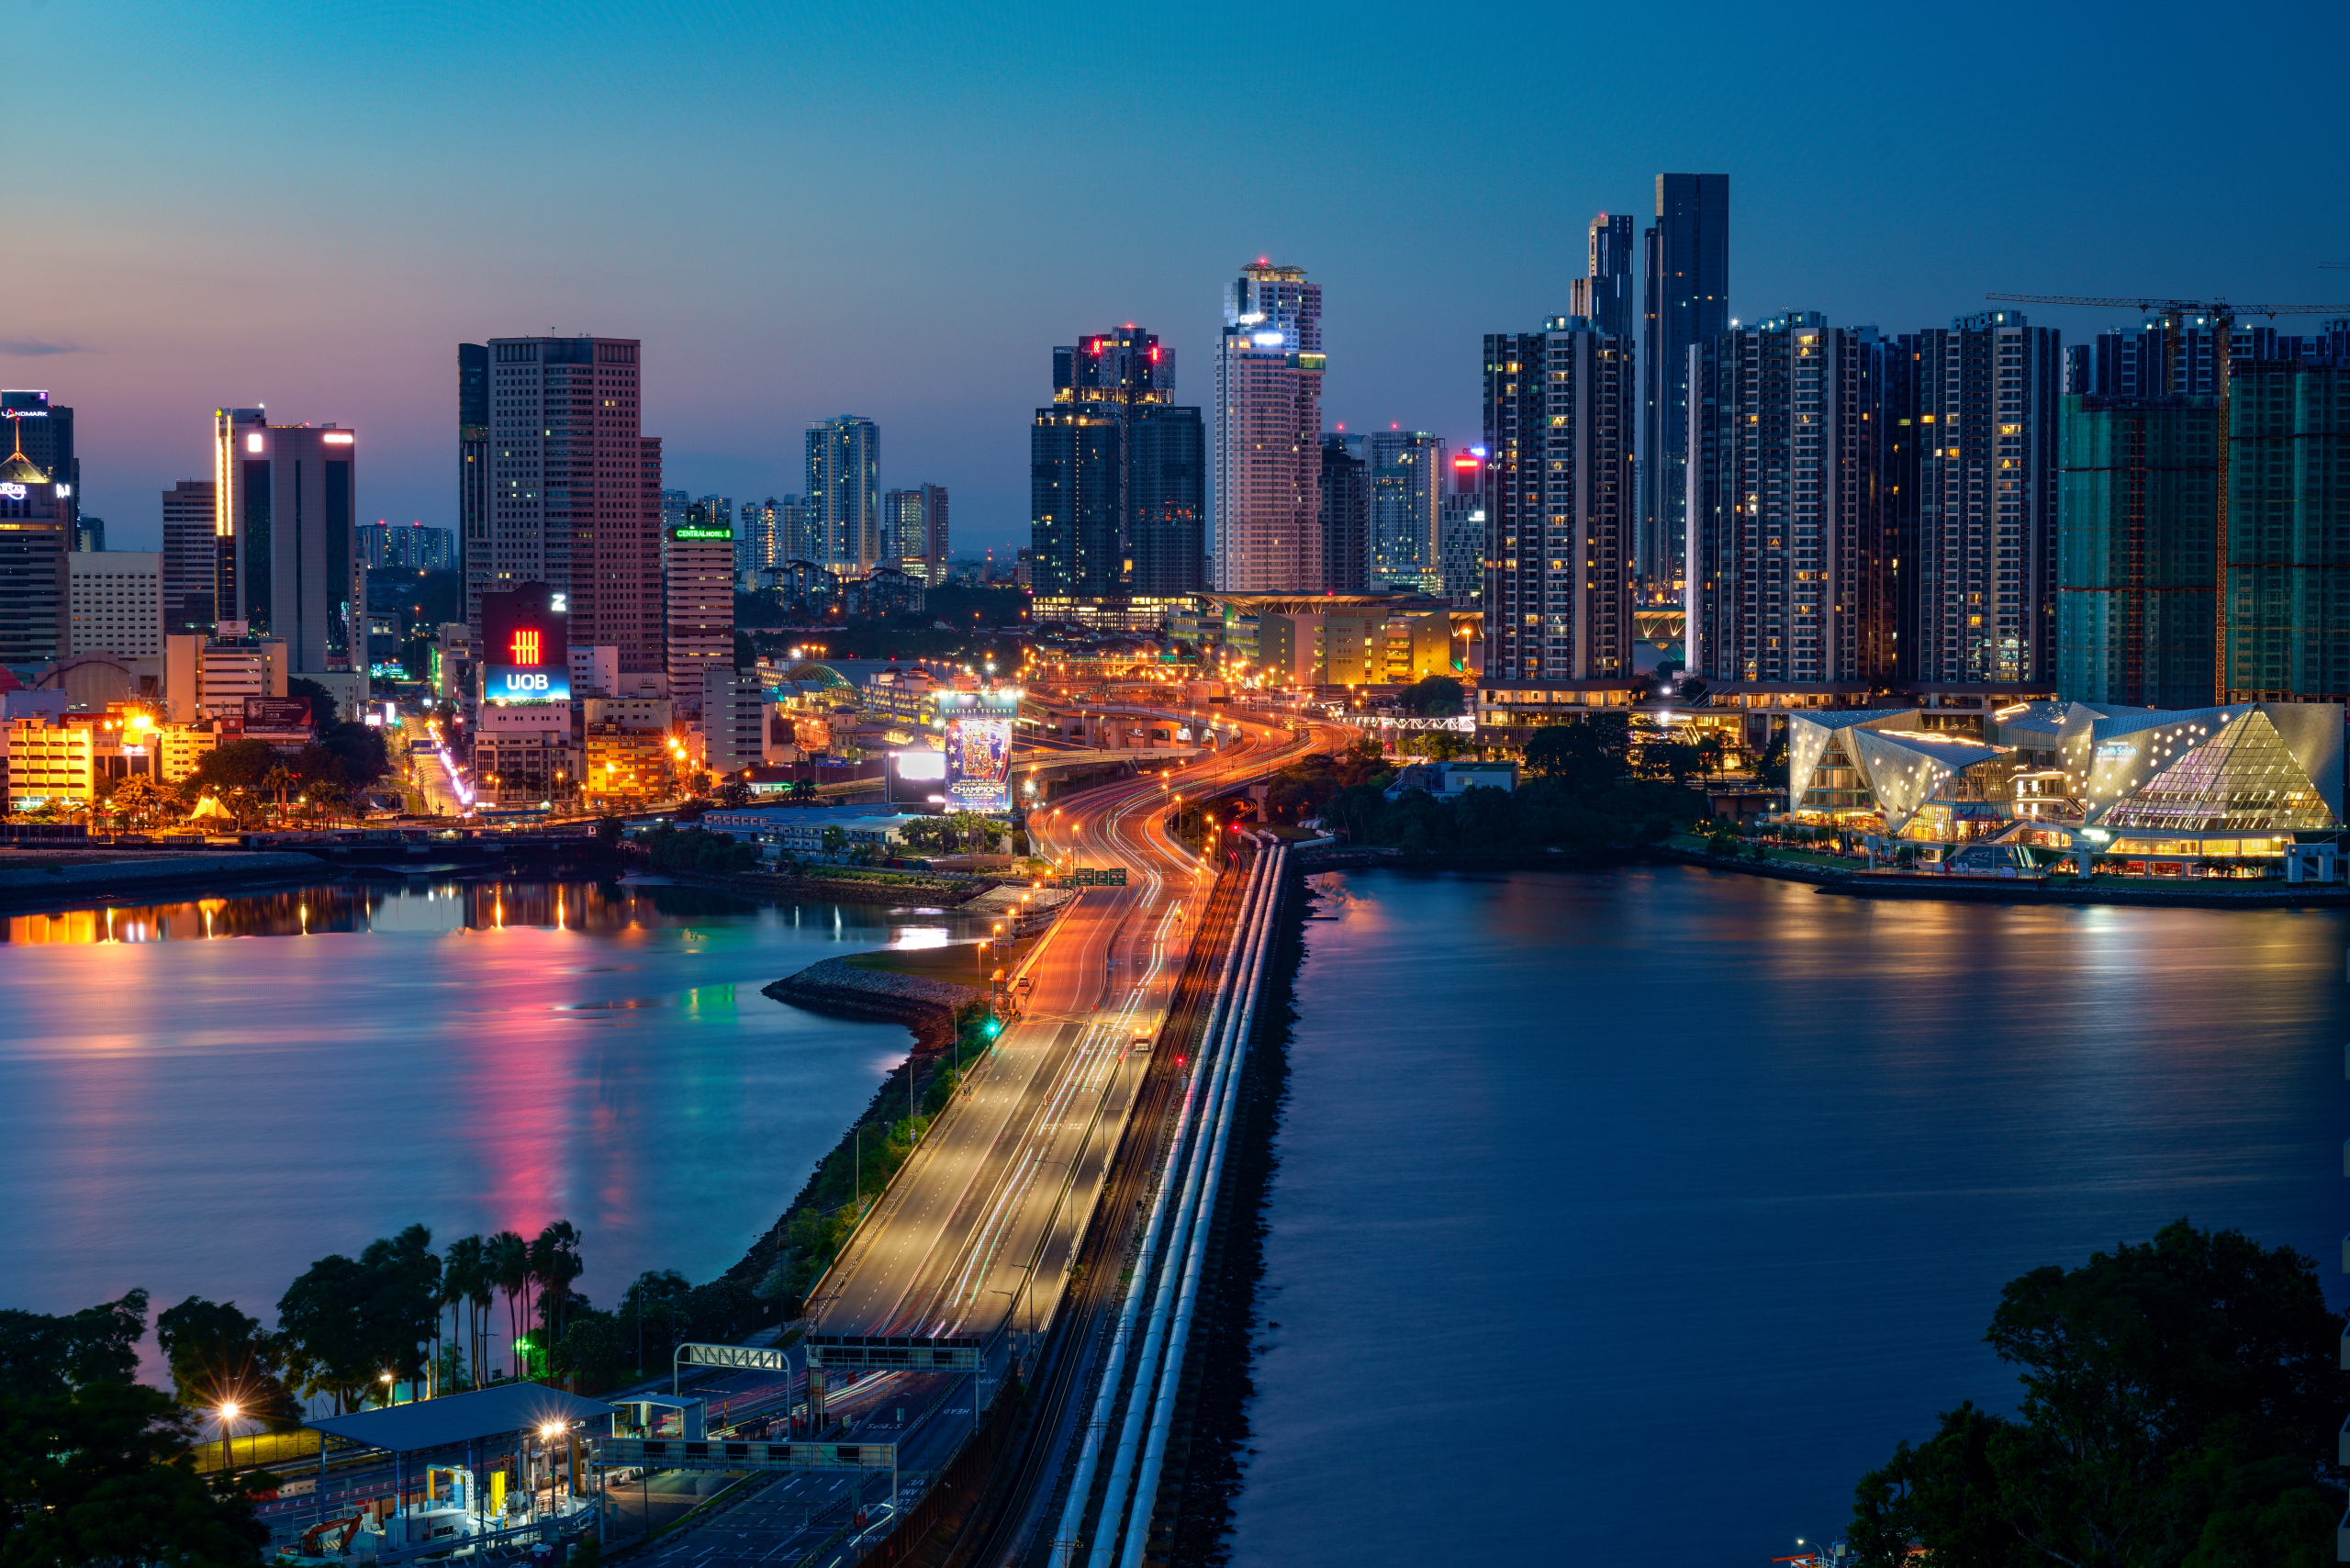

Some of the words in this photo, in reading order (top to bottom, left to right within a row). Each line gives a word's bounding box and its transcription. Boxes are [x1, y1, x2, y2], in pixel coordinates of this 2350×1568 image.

[1, 409, 48, 419] LANDMARK
[677, 530, 706, 538] CENTRAL
[507, 674, 549, 690] UOB
